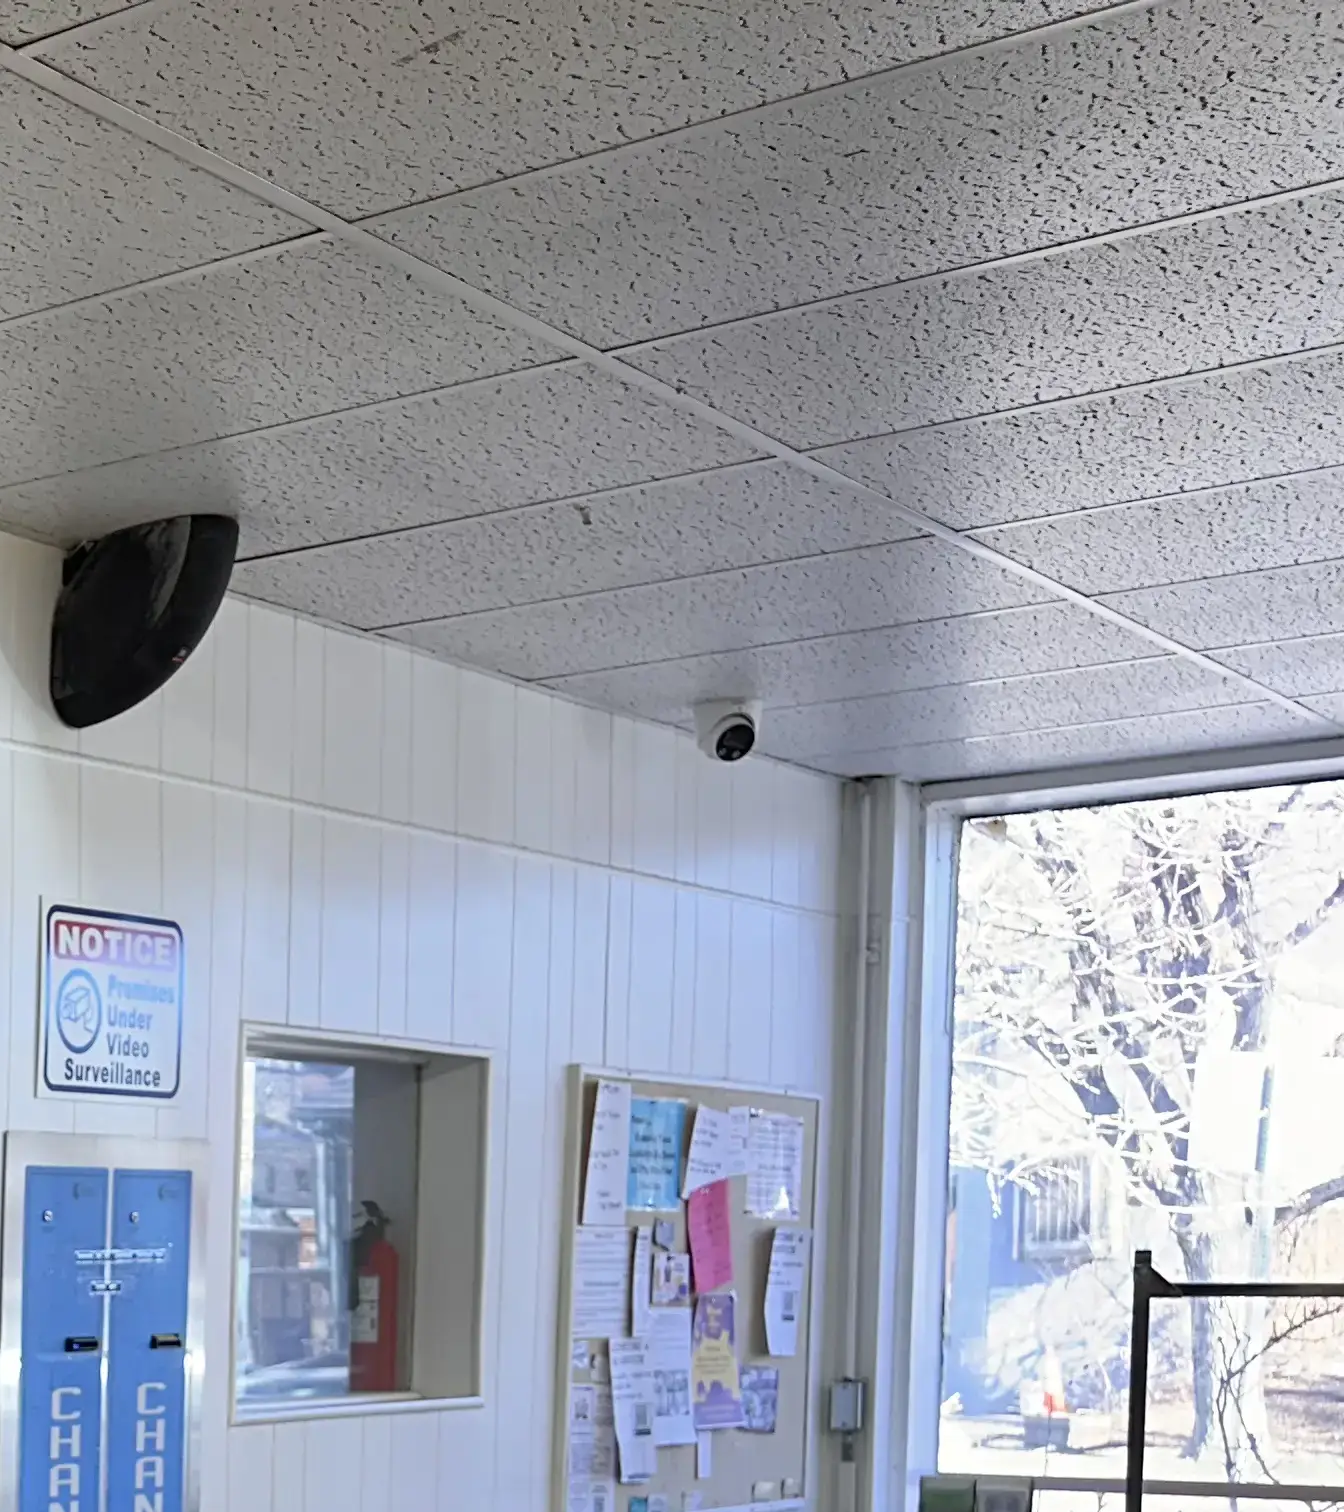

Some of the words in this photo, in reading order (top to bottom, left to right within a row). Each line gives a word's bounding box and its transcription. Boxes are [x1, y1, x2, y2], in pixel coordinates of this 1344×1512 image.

[57, 924, 173, 966] NOTICE
[107, 1005, 153, 1031] Under
[106, 1032, 150, 1058] Video
[64, 1058, 162, 1087] Surveillance
